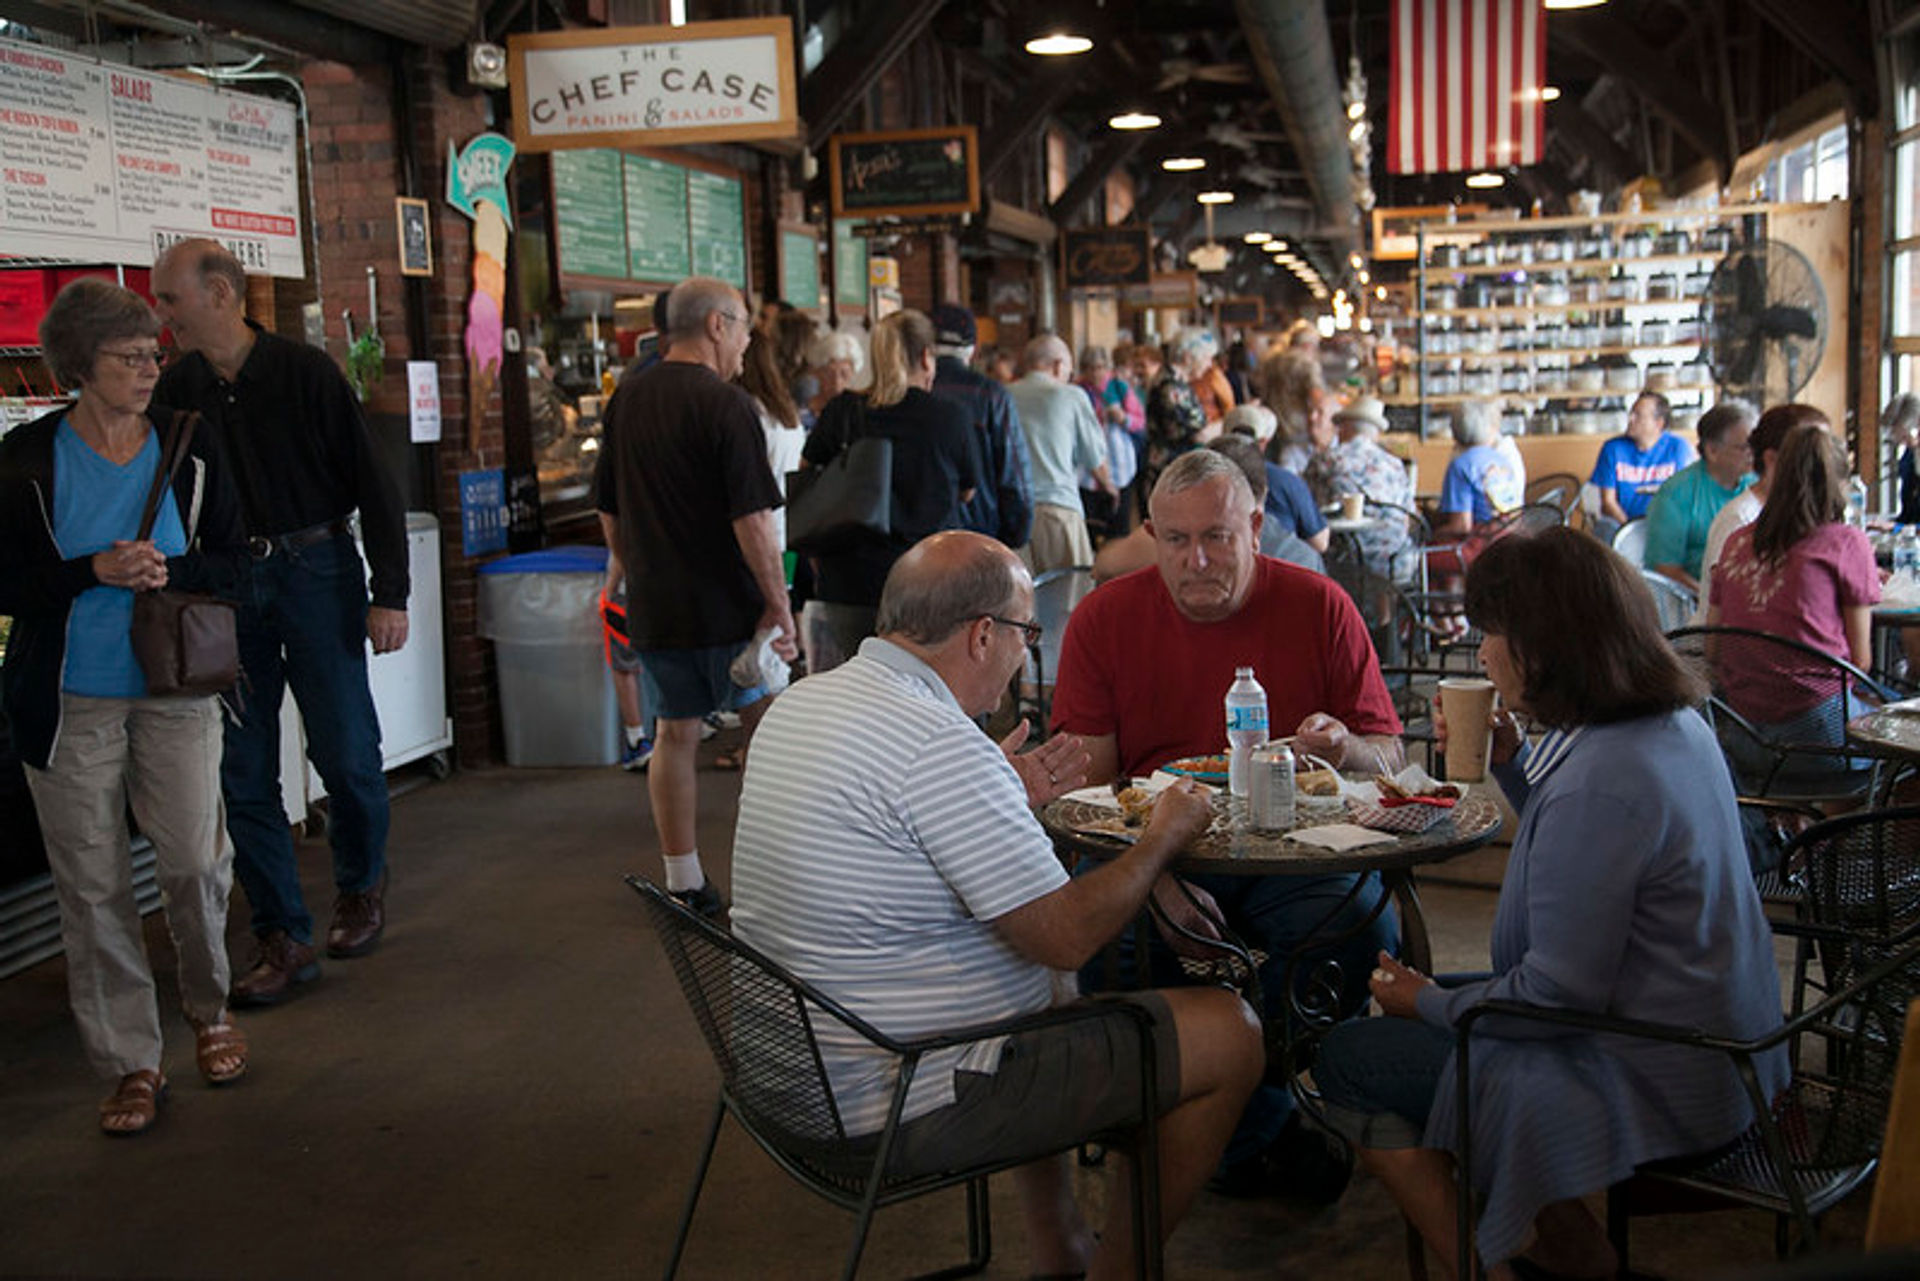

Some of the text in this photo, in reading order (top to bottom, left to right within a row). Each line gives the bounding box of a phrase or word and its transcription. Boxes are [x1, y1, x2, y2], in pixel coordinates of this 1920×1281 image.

[619, 47, 682, 63] THE
[111, 73, 152, 103] SALADS
[531, 68, 774, 124] CHEF CASE
[567, 98, 744, 128] PANINI & SALADS
